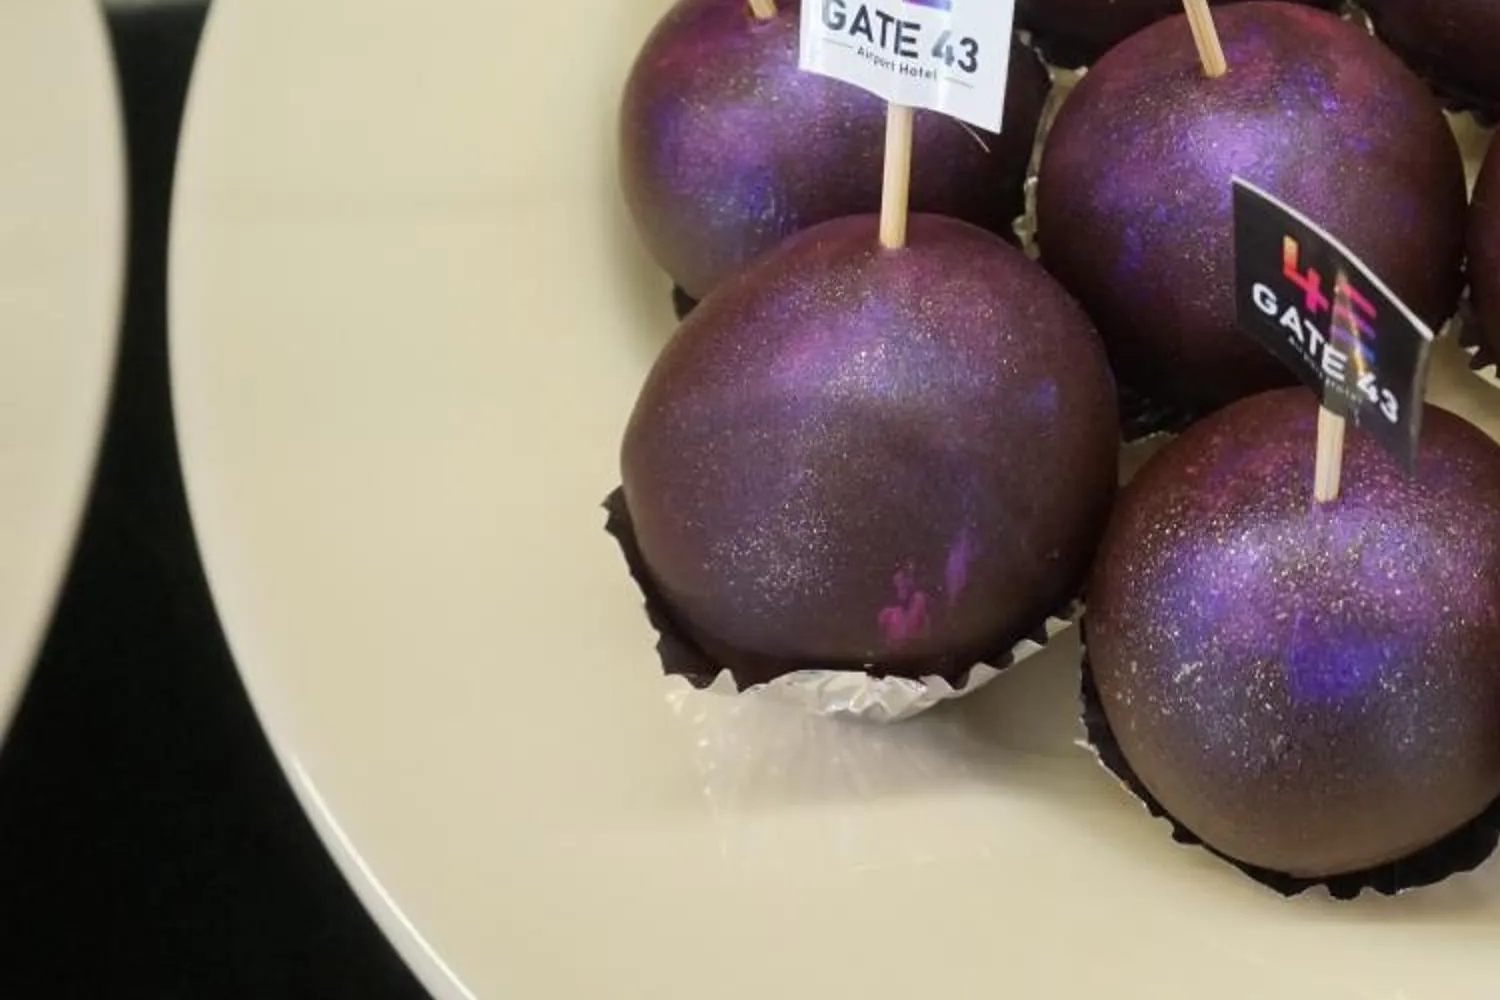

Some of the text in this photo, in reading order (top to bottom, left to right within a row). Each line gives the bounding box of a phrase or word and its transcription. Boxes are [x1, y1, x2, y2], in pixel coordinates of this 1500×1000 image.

[857, 46, 937, 81] Airport Hotel
[931, 30, 979, 74] 43
[1251, 283, 1344, 380] GATE
[1357, 372, 1399, 423] 43
